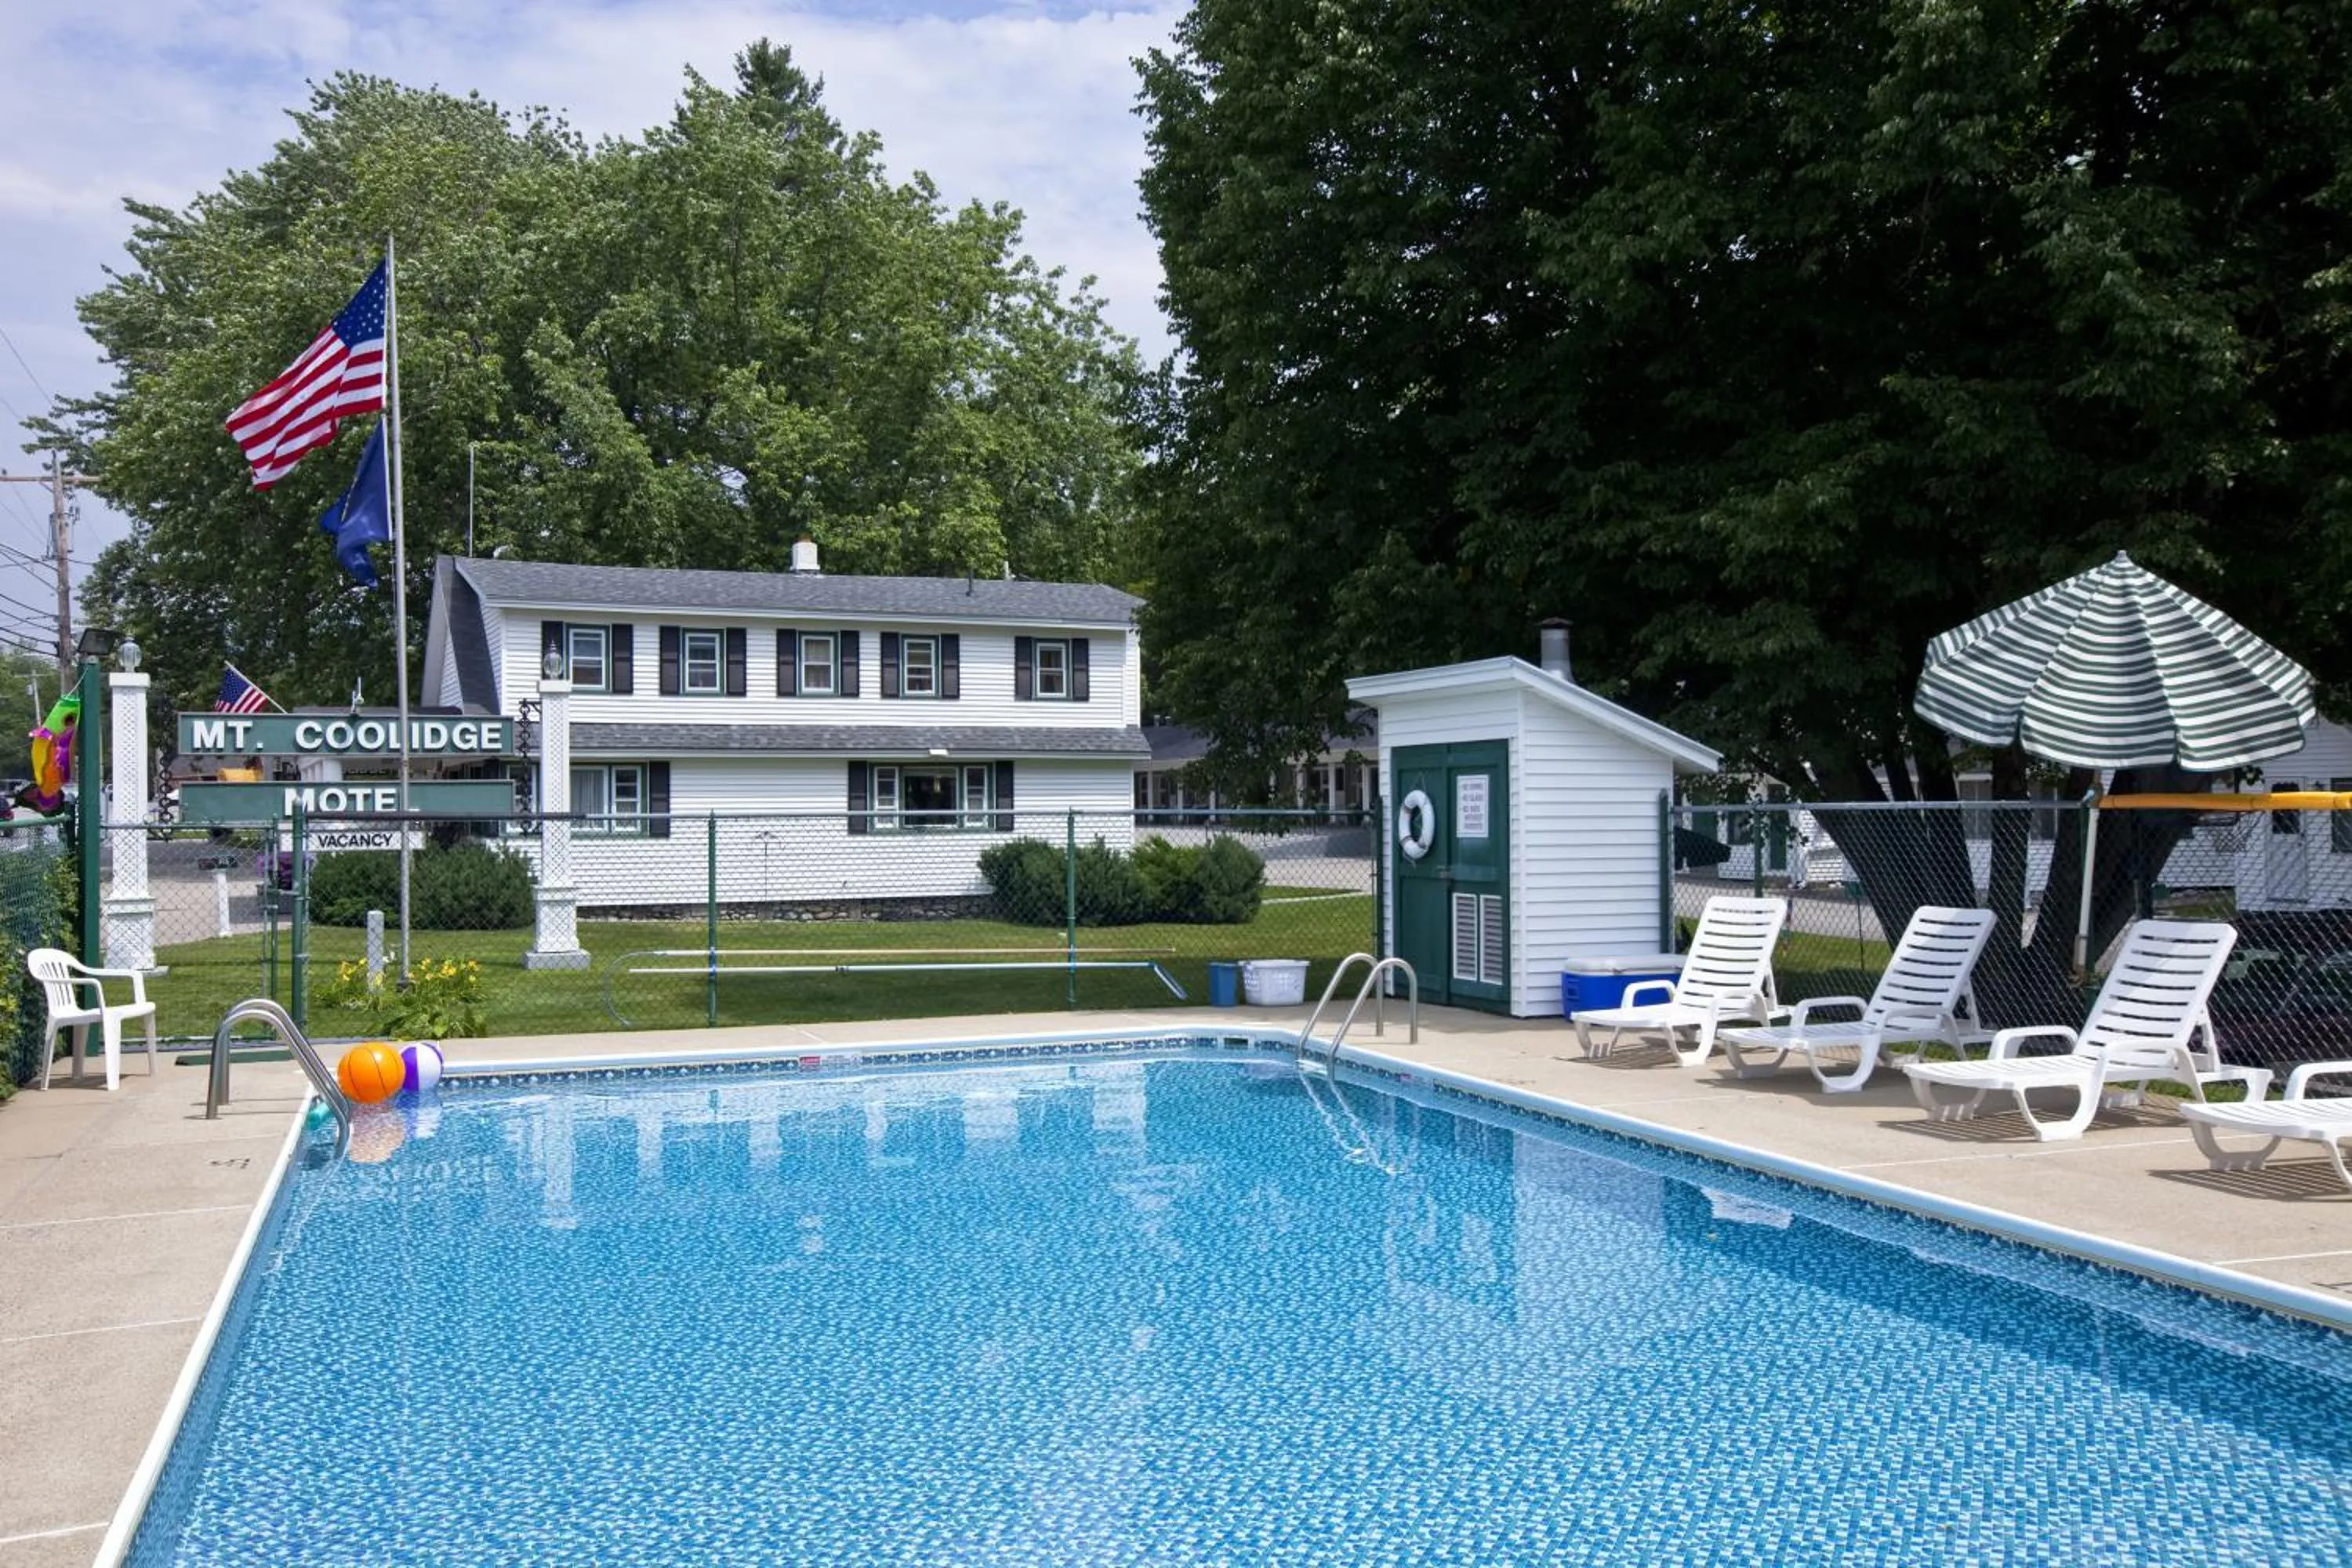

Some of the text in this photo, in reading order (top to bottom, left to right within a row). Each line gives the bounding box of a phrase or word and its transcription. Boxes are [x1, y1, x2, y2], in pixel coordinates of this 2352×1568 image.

[192, 720, 503, 750] MT. COOLIDGE
[285, 788, 420, 815] MOTE
[318, 833, 392, 848] VACANCY
